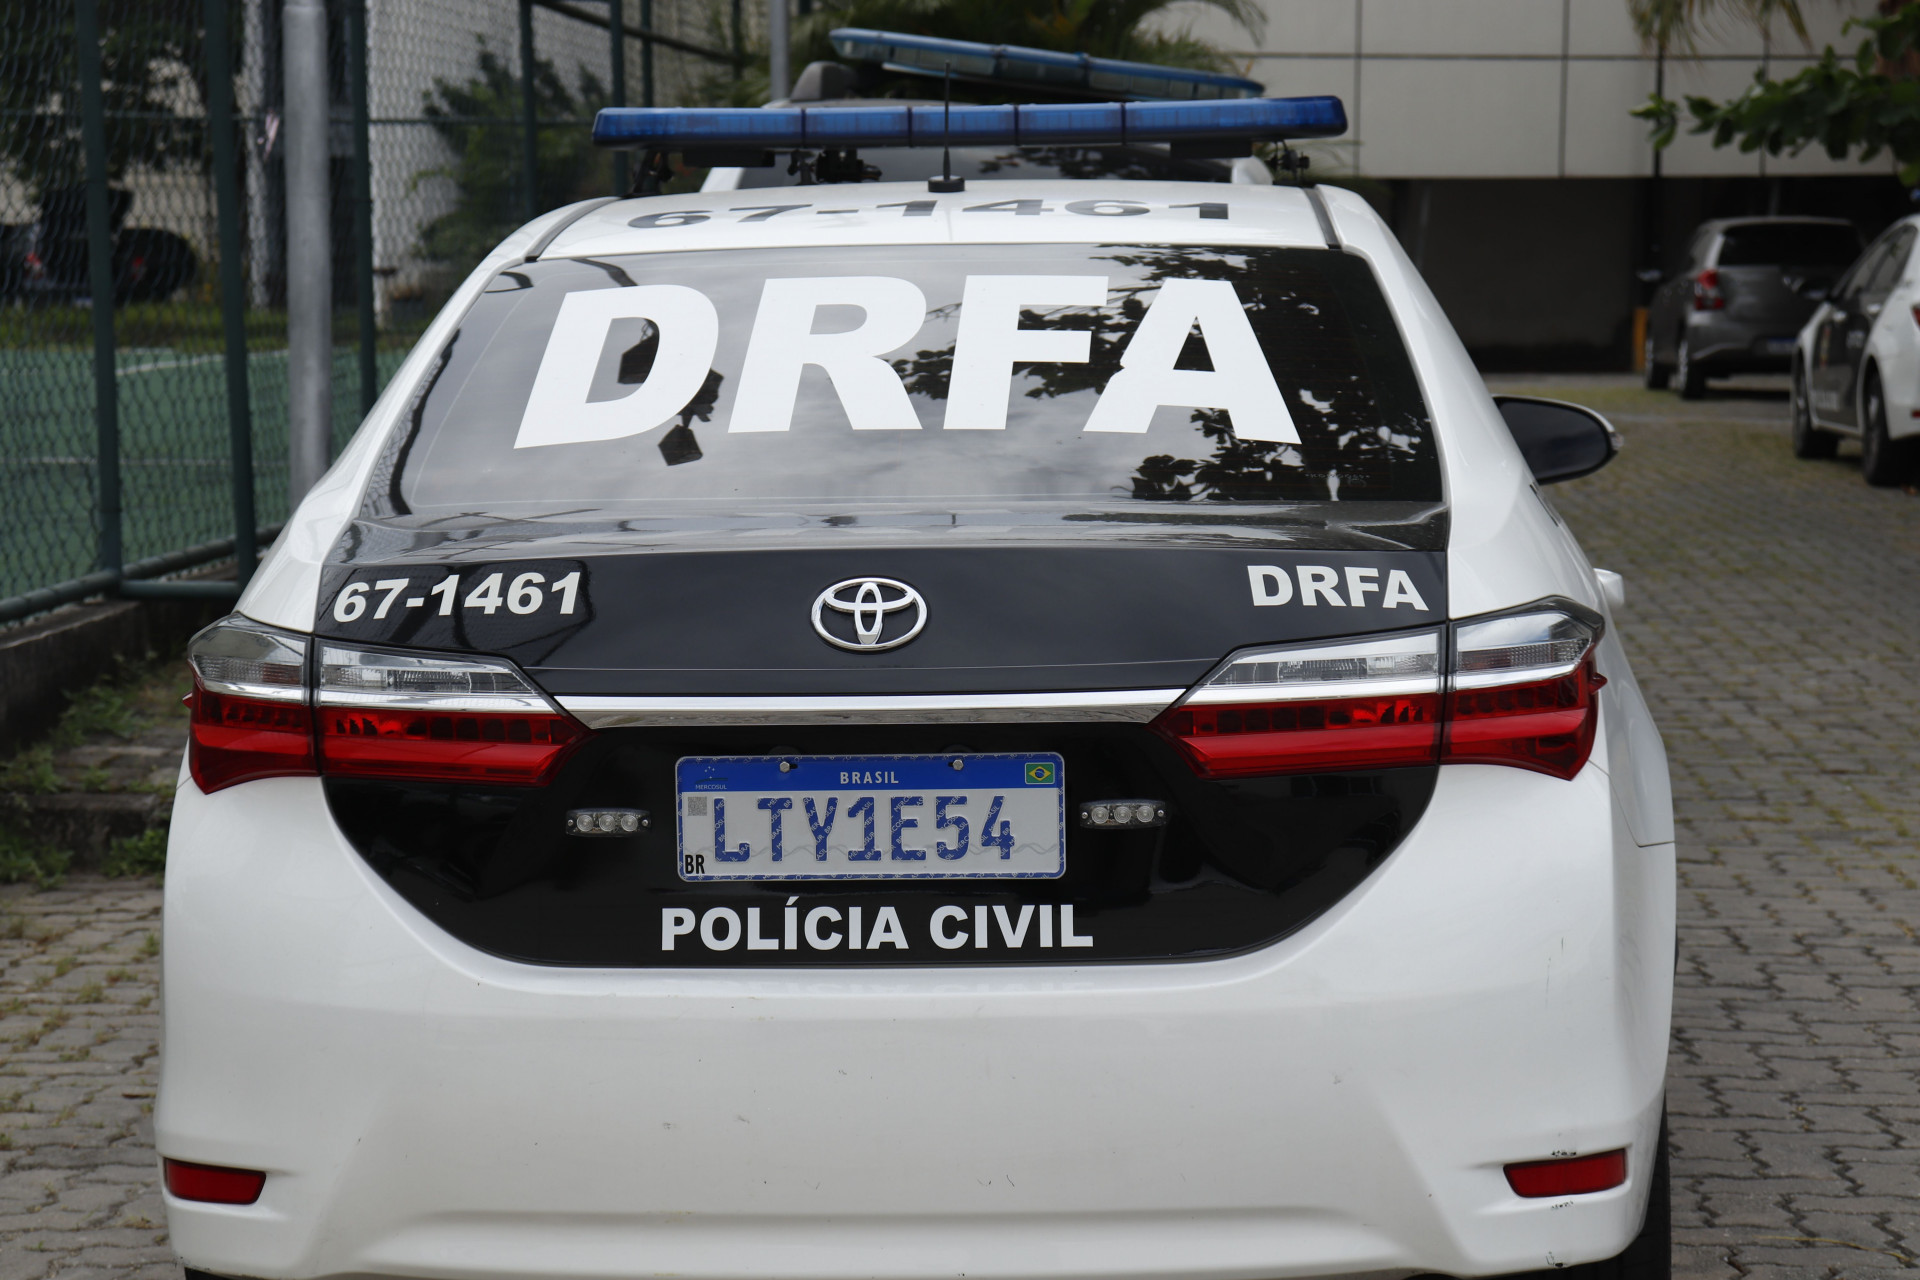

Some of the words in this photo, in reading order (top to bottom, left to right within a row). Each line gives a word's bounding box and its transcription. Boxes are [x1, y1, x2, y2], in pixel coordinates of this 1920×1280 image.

[627, 199, 1229, 229] 67-1461
[513, 275, 1302, 449] DRFA
[333, 571, 581, 623] 67-1461
[1247, 565, 1430, 611] DRFA
[839, 770, 900, 785] BRASIL
[713, 795, 1016, 863] LTY1E54
[684, 854, 706, 875] BR
[661, 896, 909, 951] POLÍCIA
[929, 904, 1094, 950] CIVIL
